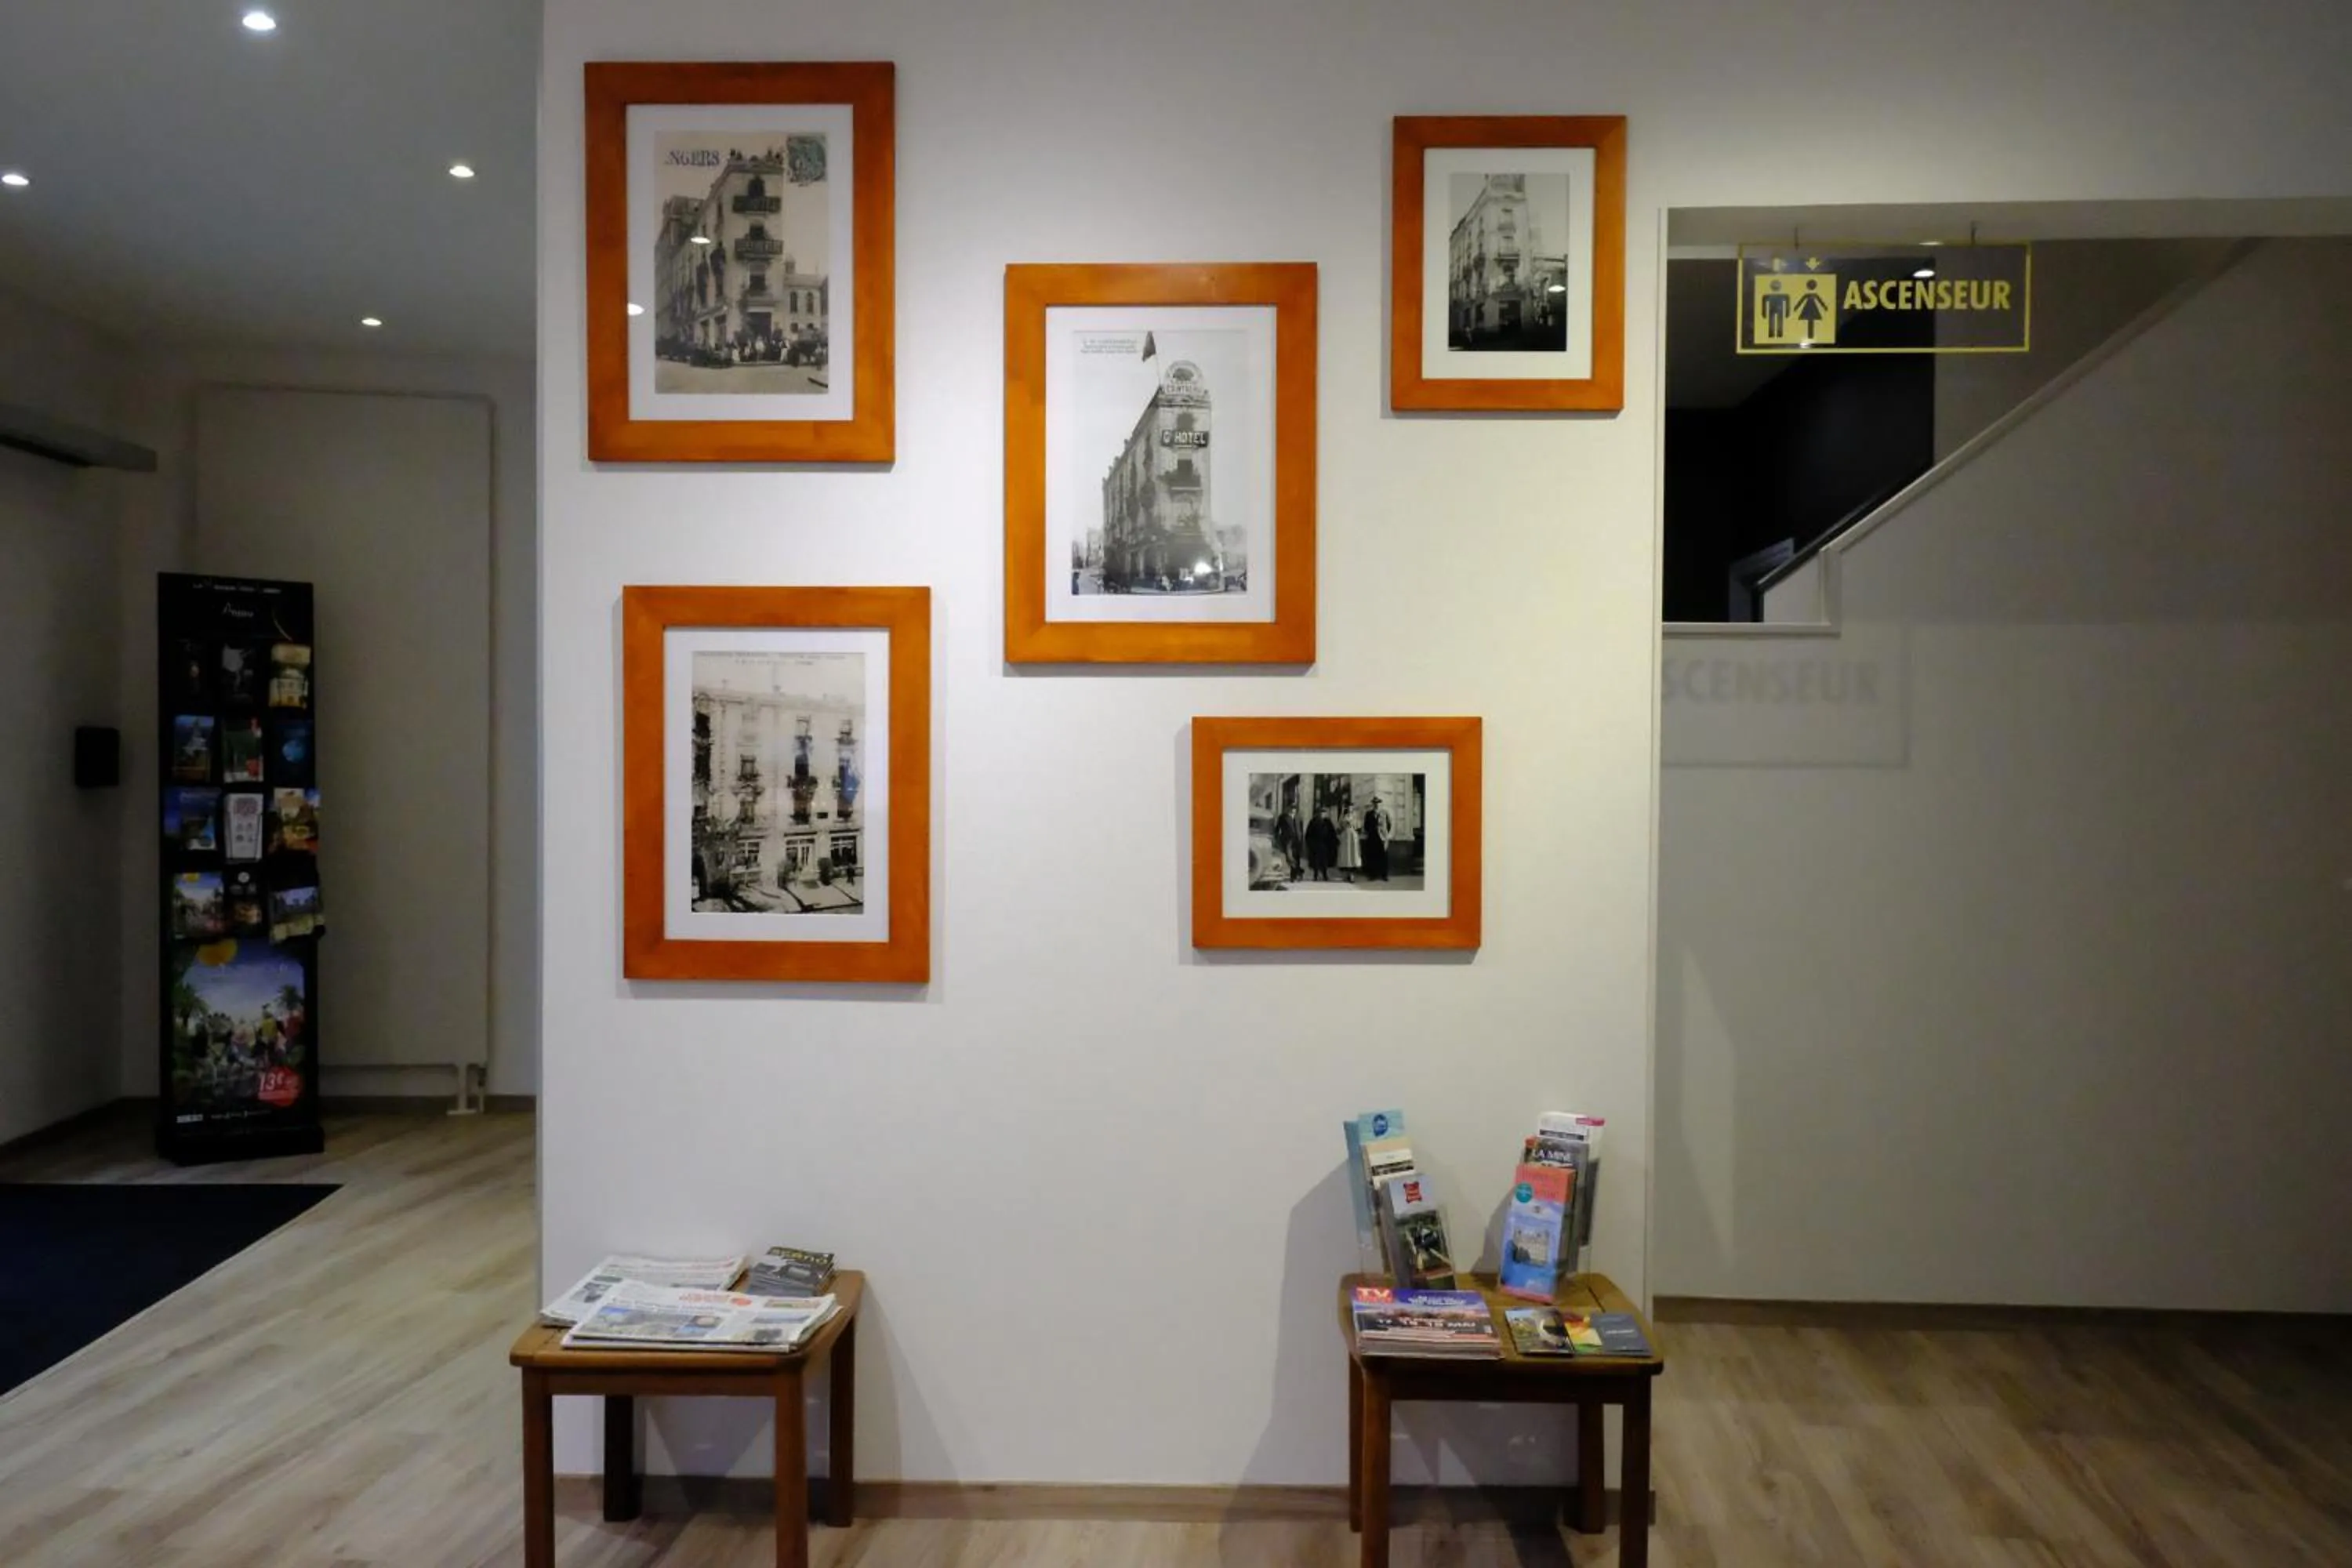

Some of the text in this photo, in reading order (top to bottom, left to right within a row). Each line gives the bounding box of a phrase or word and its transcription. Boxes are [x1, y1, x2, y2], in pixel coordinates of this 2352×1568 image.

[1843, 280, 2011, 310] ASCENSEUR
[1174, 432, 1206, 445] HOTEL
[1356, 1287, 1391, 1298] TV
